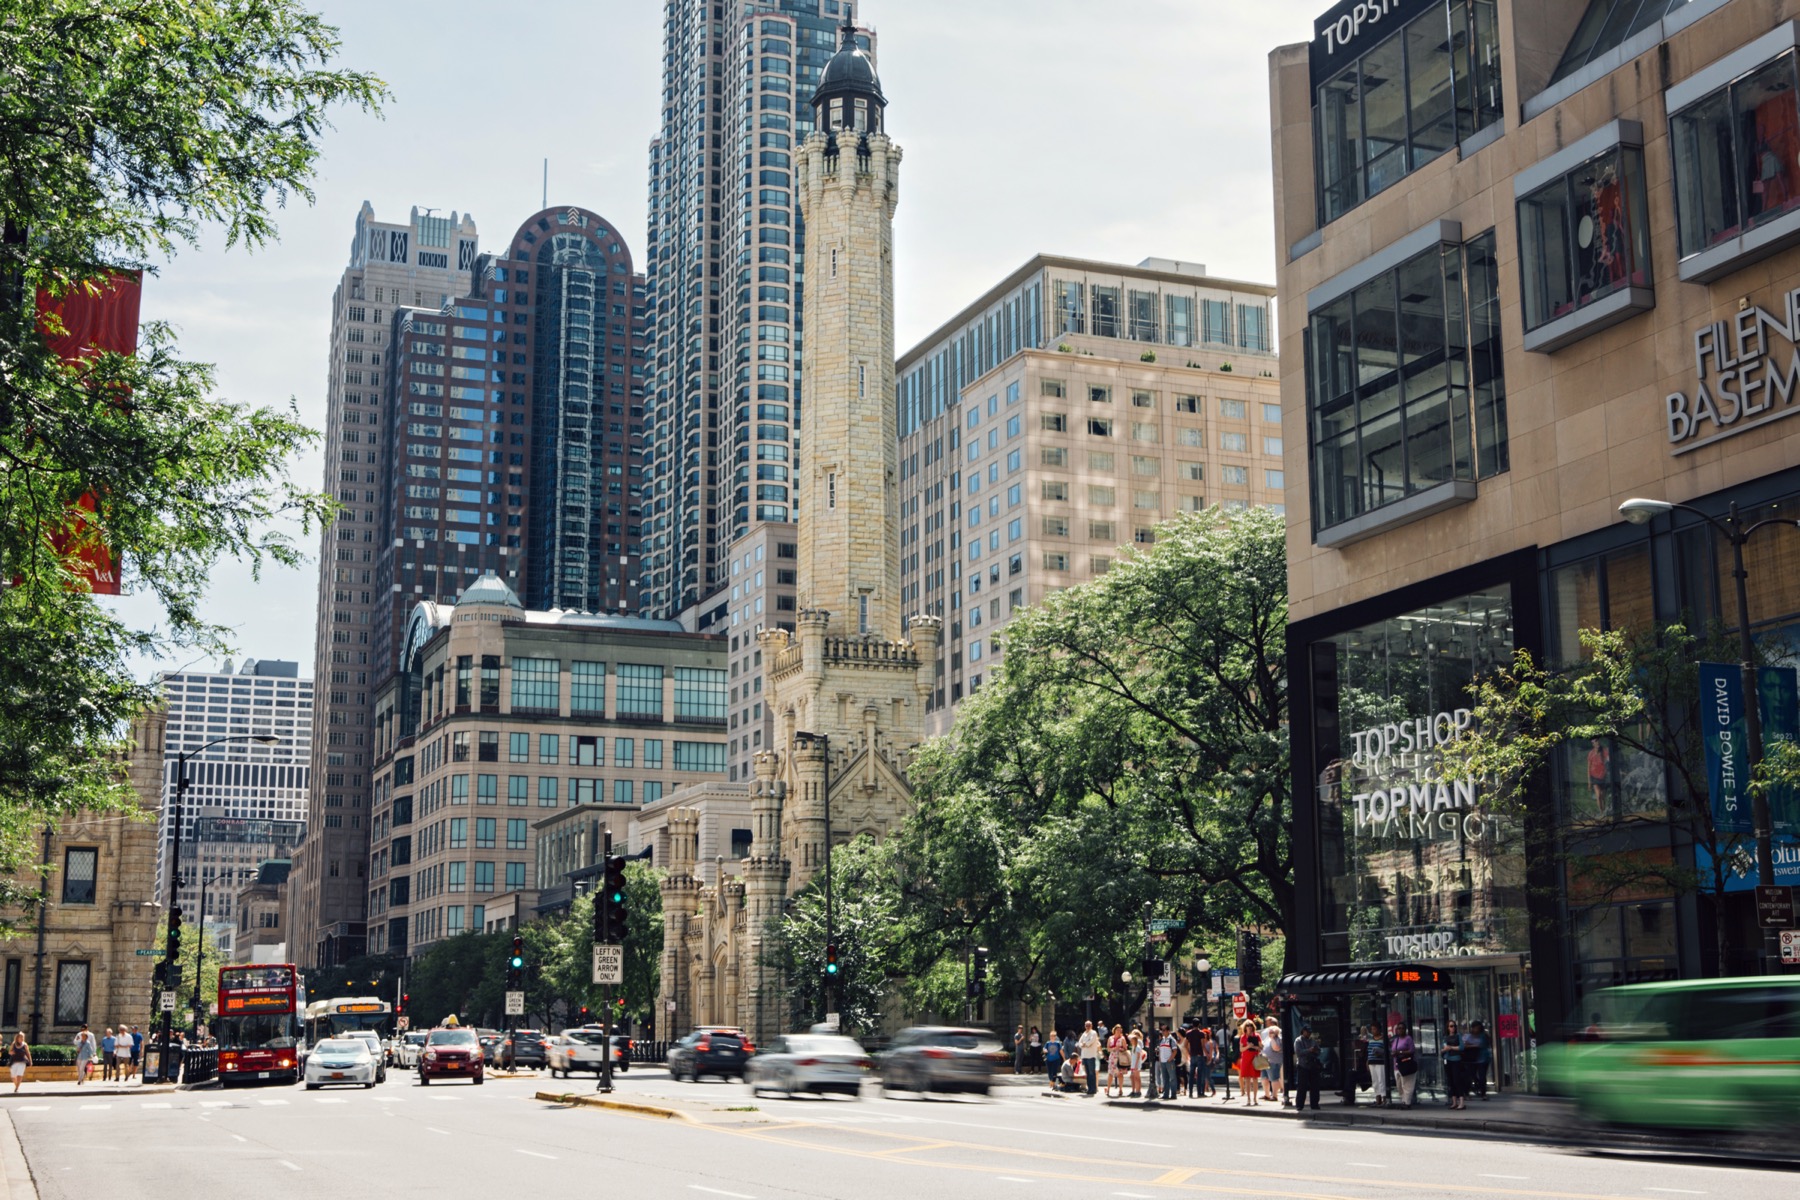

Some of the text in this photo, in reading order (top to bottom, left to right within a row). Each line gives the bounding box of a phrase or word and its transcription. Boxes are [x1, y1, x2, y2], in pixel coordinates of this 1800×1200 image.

[94, 568, 114, 583] V&A
[1350, 708, 1471, 763] TOPSHOP
[1772, 731, 1784, 742] Sep
[1714, 677, 1737, 812] DAVID BOWIE IS
[1352, 774, 1476, 826] TOPMAN
[1759, 902, 1791, 910] CONTEMPORARY
[1384, 931, 1453, 955] TOPSHOP
[597, 964, 618, 972] ARROW
[600, 972, 615, 980] ONLY
[1501, 1018, 1518, 1031] sale
